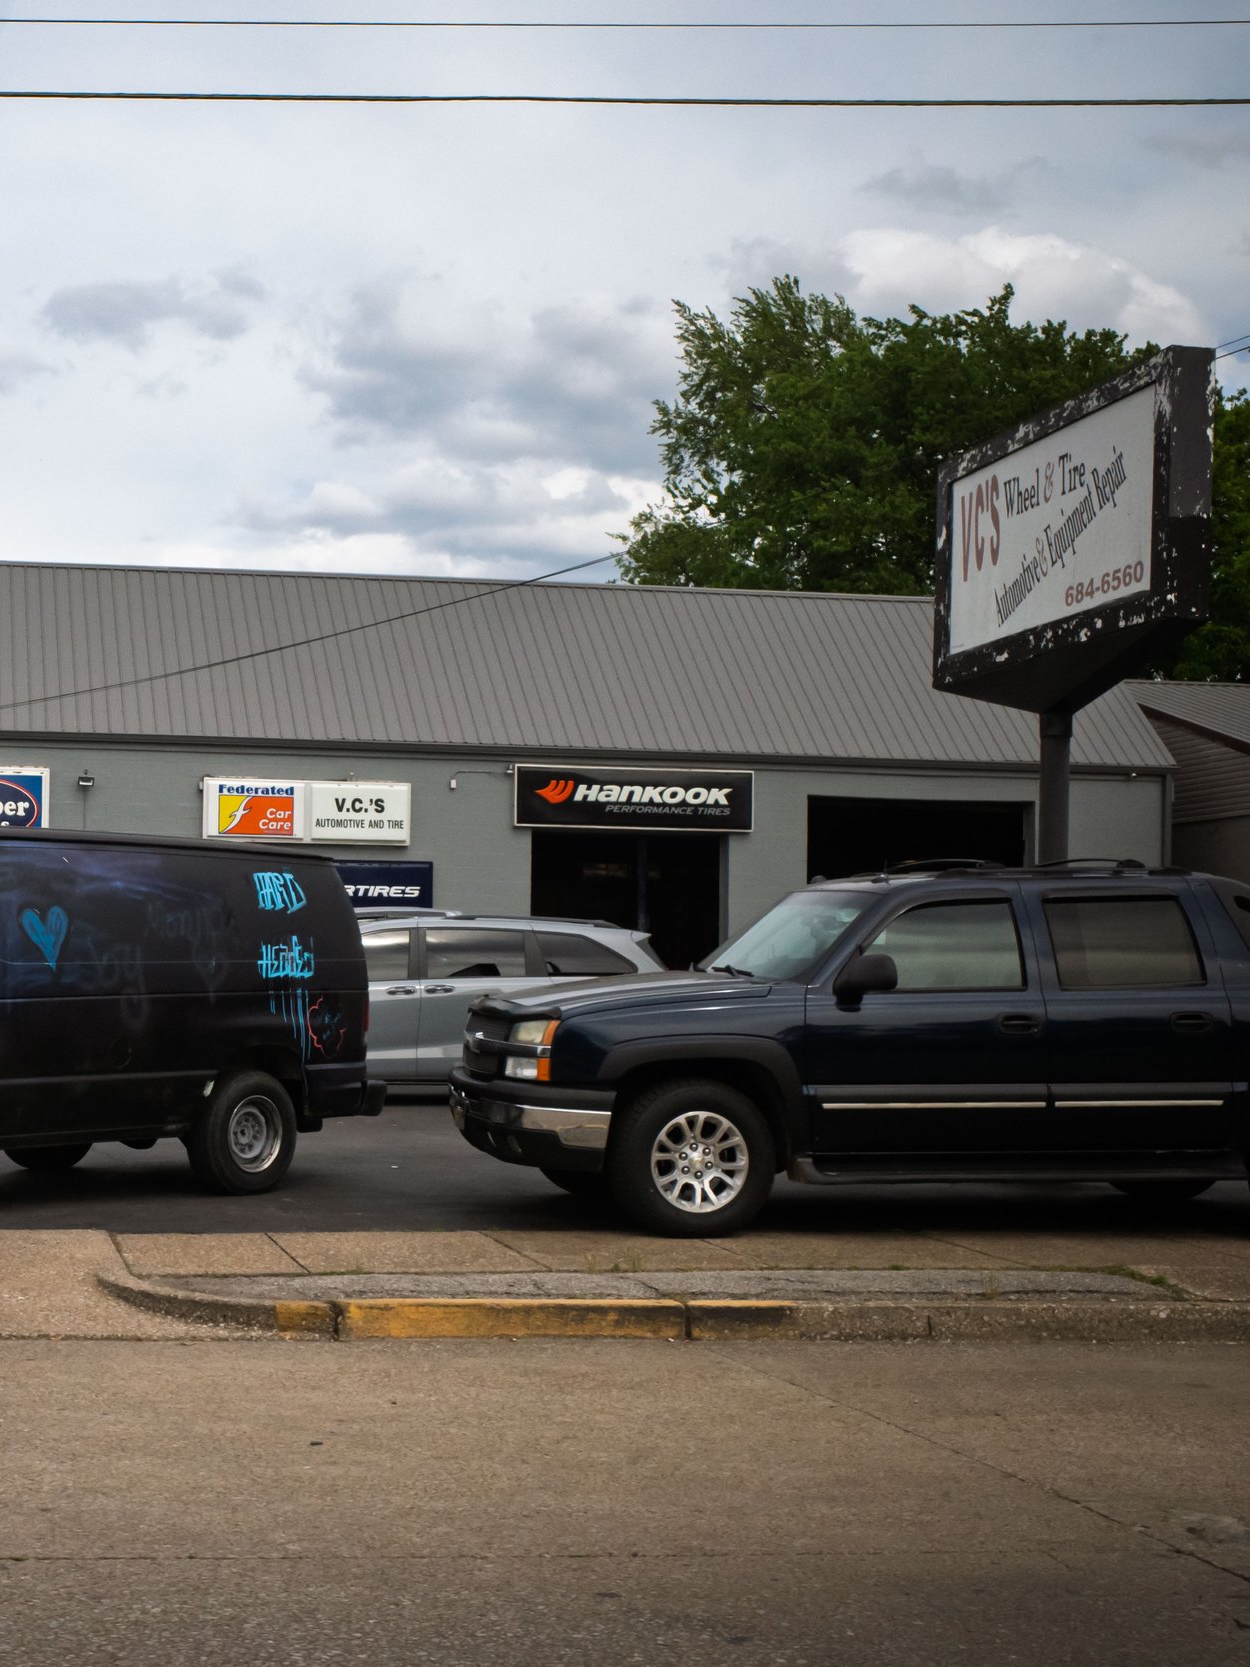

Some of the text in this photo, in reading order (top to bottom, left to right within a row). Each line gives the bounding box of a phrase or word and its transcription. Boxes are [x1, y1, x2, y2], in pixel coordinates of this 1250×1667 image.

[960, 453, 1086, 583] VC'S Wheel & Tire
[993, 445, 1127, 629] Automotive & Equipment Repair
[1064, 560, 1145, 608] 684-6560
[218, 783, 295, 796] Federated
[334, 797, 386, 814] V.C.'S
[605, 804, 731, 816] PERFORMANCE TIRES
[266, 807, 292, 818] Car
[258, 819, 292, 830] Care
[315, 818, 405, 830] AUTOMOTIVE AND TIRE
